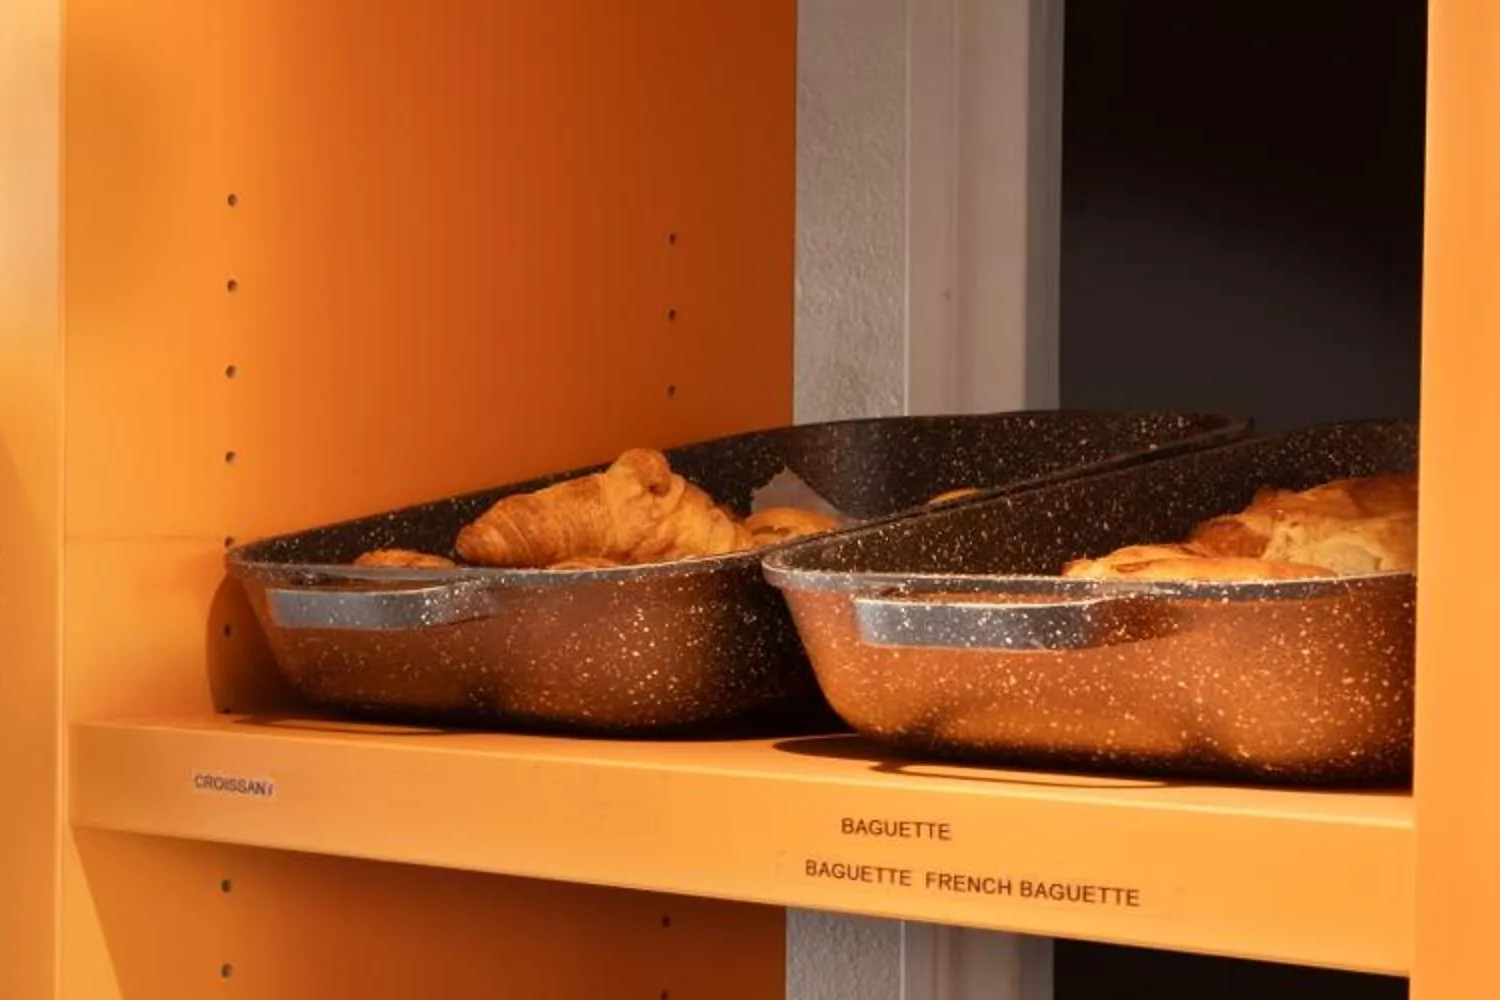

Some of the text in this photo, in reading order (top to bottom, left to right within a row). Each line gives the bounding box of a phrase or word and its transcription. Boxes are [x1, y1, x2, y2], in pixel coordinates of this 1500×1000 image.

[840, 817, 953, 841] BAGUETTE
[804, 859, 1142, 908] BAGUETTE FRENCH BAGUETTE
